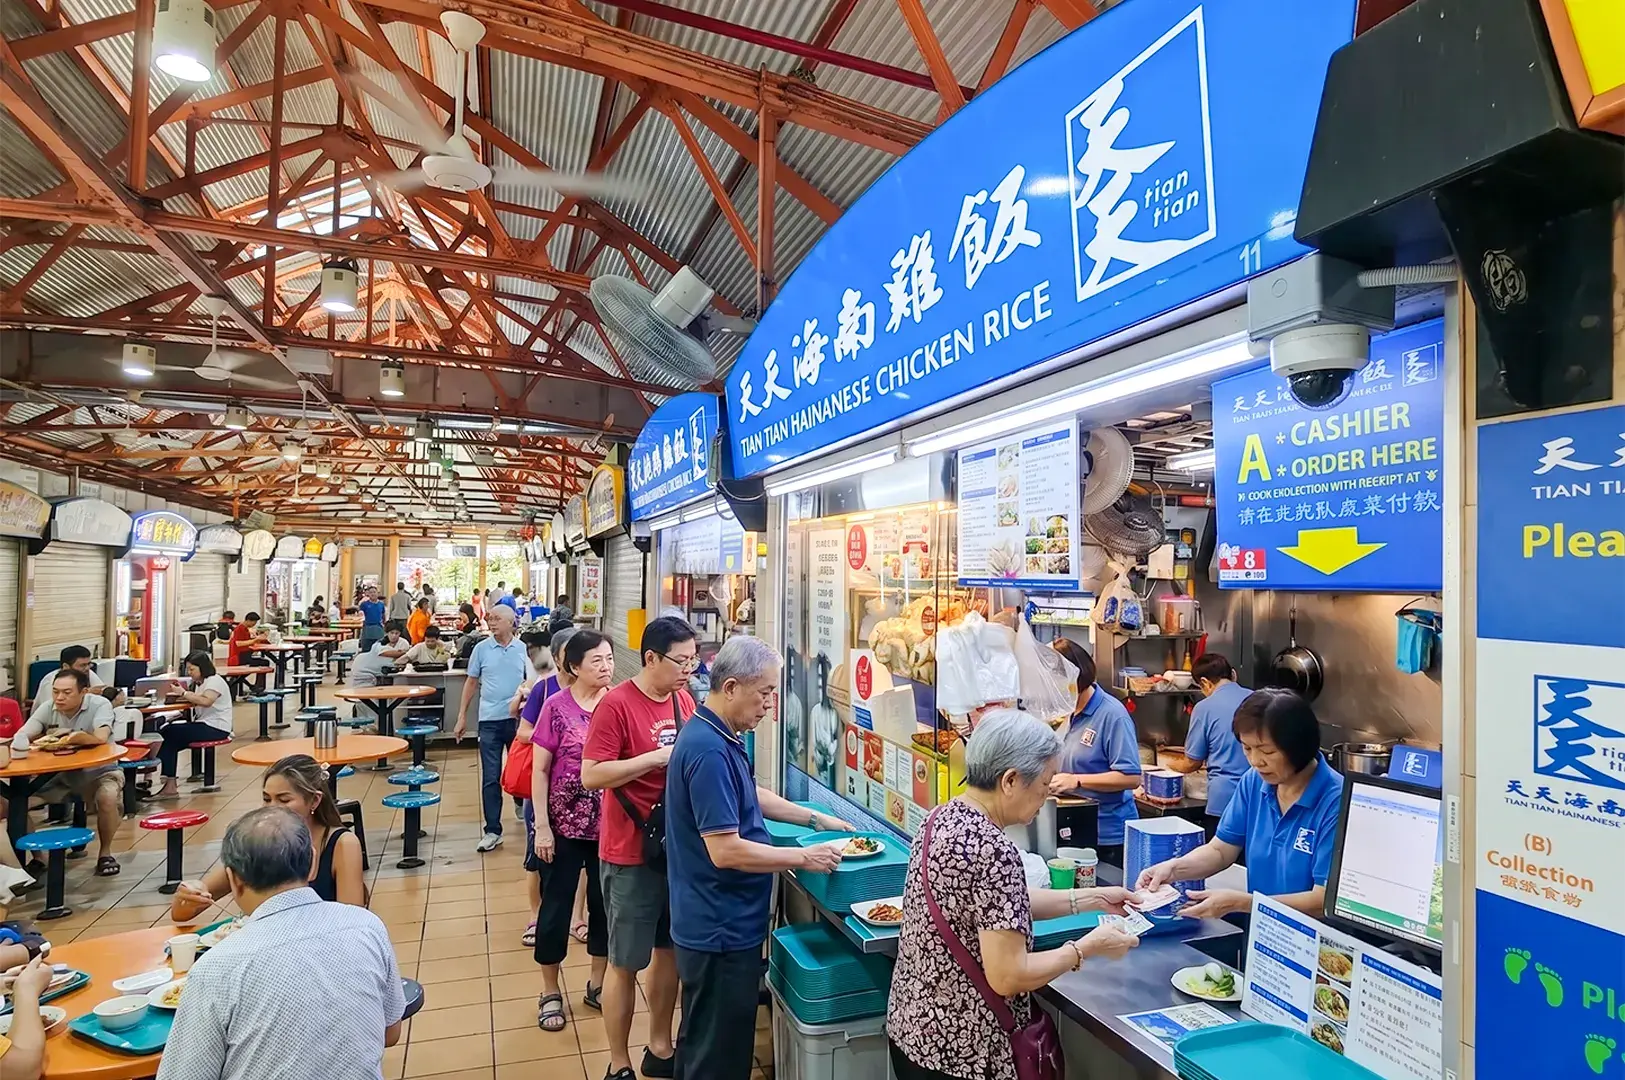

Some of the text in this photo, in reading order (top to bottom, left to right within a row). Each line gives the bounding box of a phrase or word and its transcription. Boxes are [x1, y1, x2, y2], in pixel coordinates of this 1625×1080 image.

[1144, 169, 1189, 209] tian
[1153, 188, 1199, 229] tian
[1239, 240, 1262, 276] 11
[740, 432, 763, 458] TIAN
[764, 417, 789, 445] TIAN
[790, 376, 871, 437] HAINANESE
[875, 321, 975, 396] CHICKEN
[983, 280, 1053, 346] RICE
[1290, 401, 1411, 446] CASHIER
[1237, 433, 1272, 484] A
[1291, 437, 1438, 478] ORDER HERE
[1533, 432, 1625, 475] 天
[1329, 479, 1357, 494] WITH
[1405, 471, 1421, 484] AT
[1531, 482, 1591, 499] TIAN
[1244, 551, 1257, 569] 8
[1504, 797, 1528, 808] TIAN
[1531, 803, 1555, 814] TIAN
[1524, 833, 1552, 856] (B)
[1486, 849, 1594, 892] Collection
